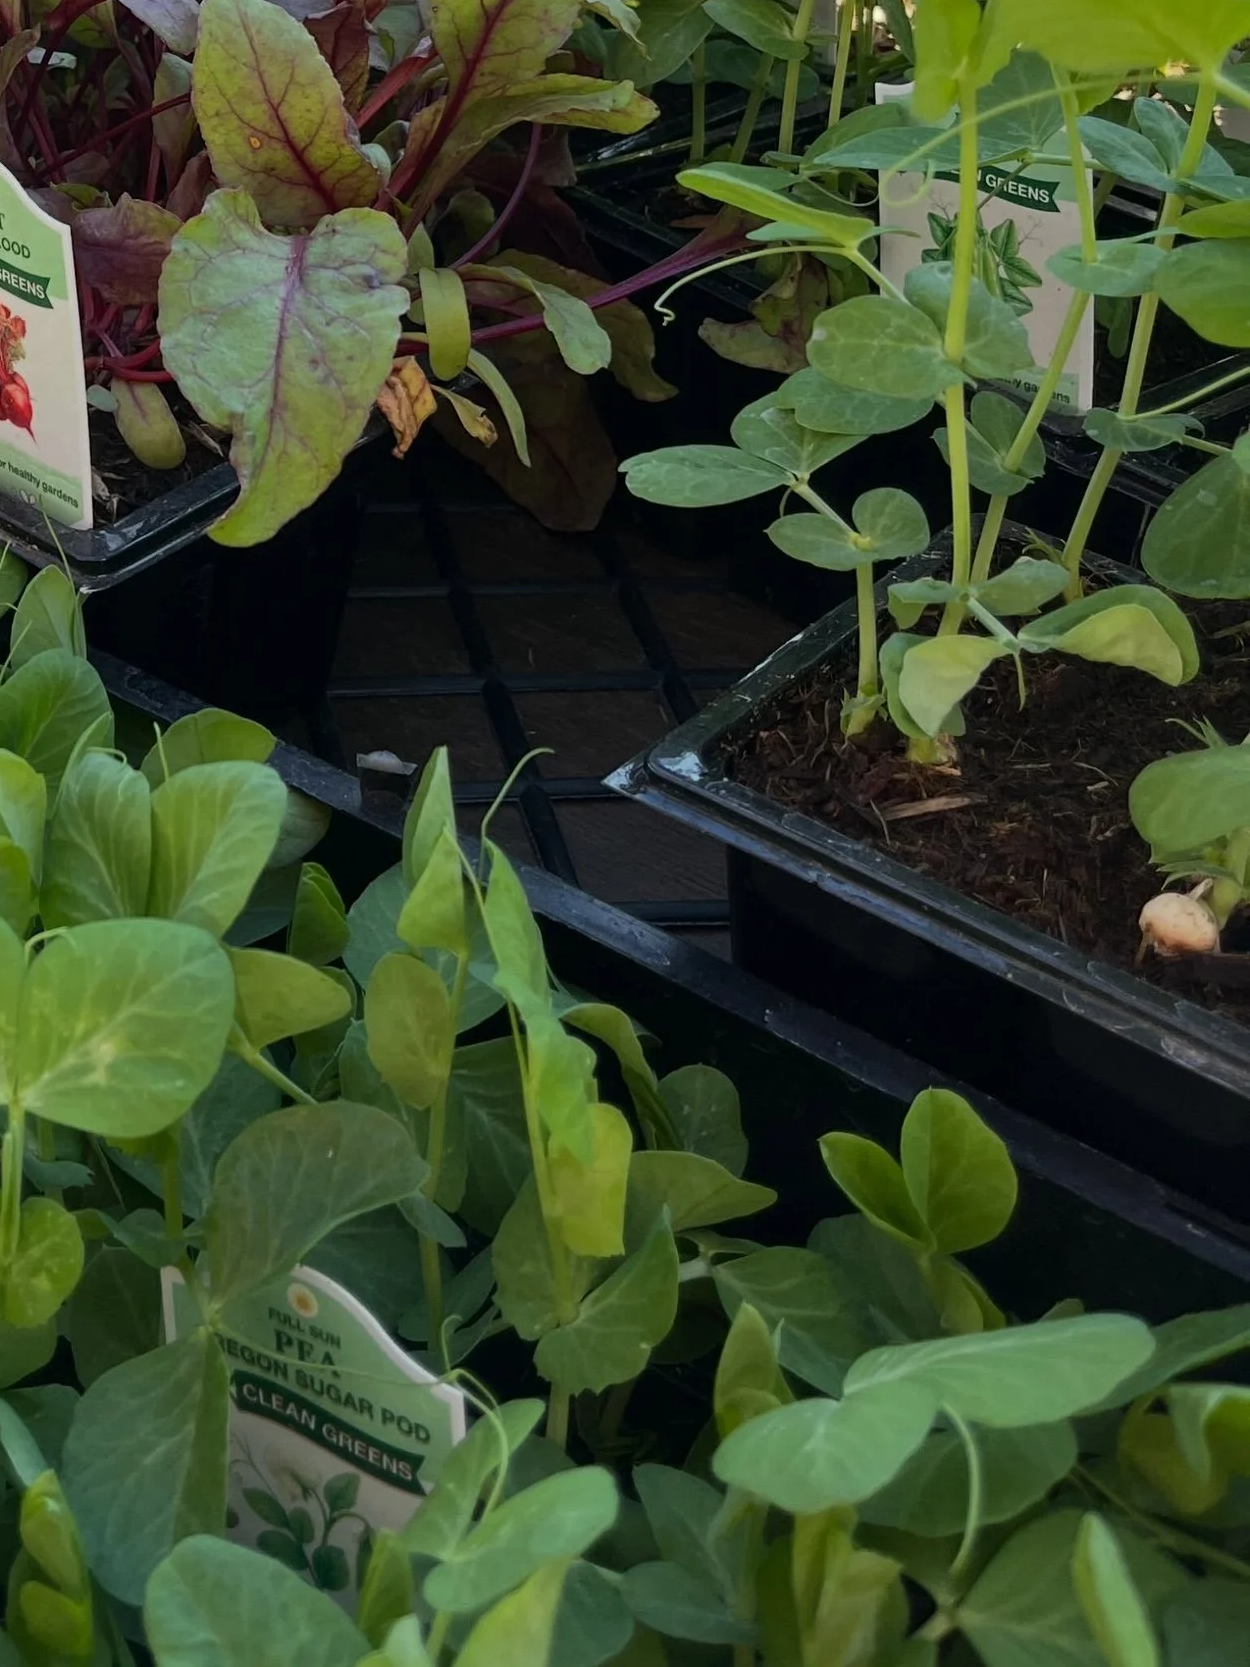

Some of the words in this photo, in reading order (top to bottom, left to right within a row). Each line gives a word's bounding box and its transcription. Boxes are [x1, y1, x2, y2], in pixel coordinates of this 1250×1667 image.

[7, 461, 41, 488] healthy
[41, 481, 79, 508] gardens
[268, 1306, 305, 1333] FULL
[309, 1325, 341, 1349] SUN
[274, 1329, 340, 1378] PEA
[295, 1368, 374, 1421] SUGAR
[381, 1407, 431, 1445] POD
[242, 1383, 317, 1431] CLEAN
[322, 1423, 413, 1481] GREENS
